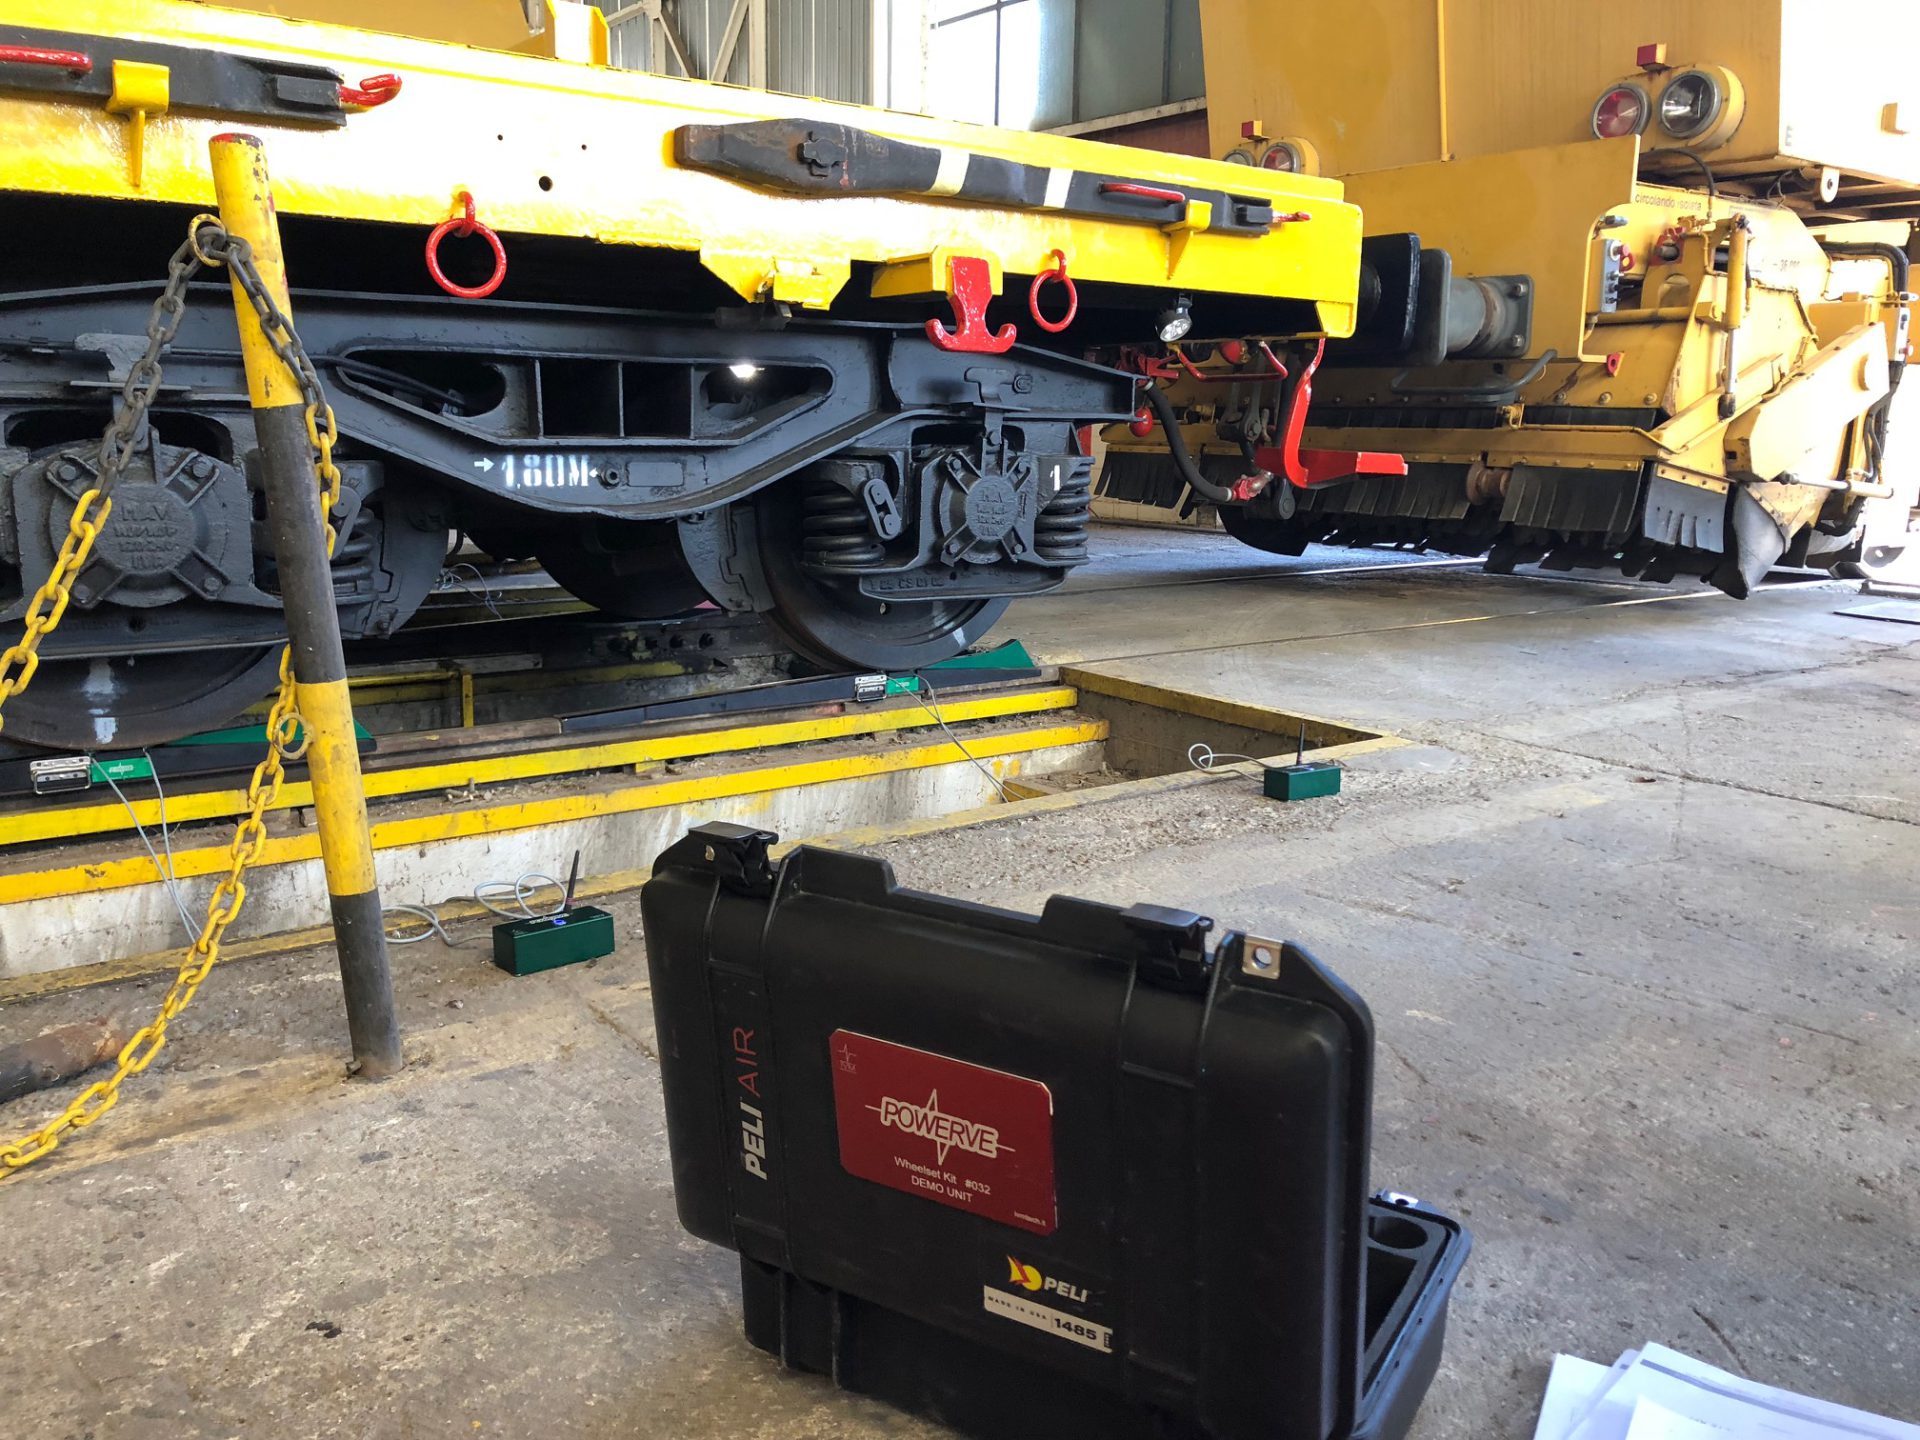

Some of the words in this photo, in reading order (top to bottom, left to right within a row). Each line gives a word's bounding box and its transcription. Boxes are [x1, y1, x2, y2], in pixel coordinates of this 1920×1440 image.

[732, 1026, 761, 1098] AIR
[740, 1101, 768, 1181] PELI
[882, 1098, 997, 1157] POWERVE
[894, 1156, 941, 1179] Wheelset
[943, 1171, 957, 1185] Kit
[965, 1179, 991, 1195] #032
[911, 1175, 944, 1193] DEMO
[946, 1186, 973, 1203] UNIT
[1043, 1277, 1089, 1303] PELI
[1055, 1318, 1097, 1340] 1485
